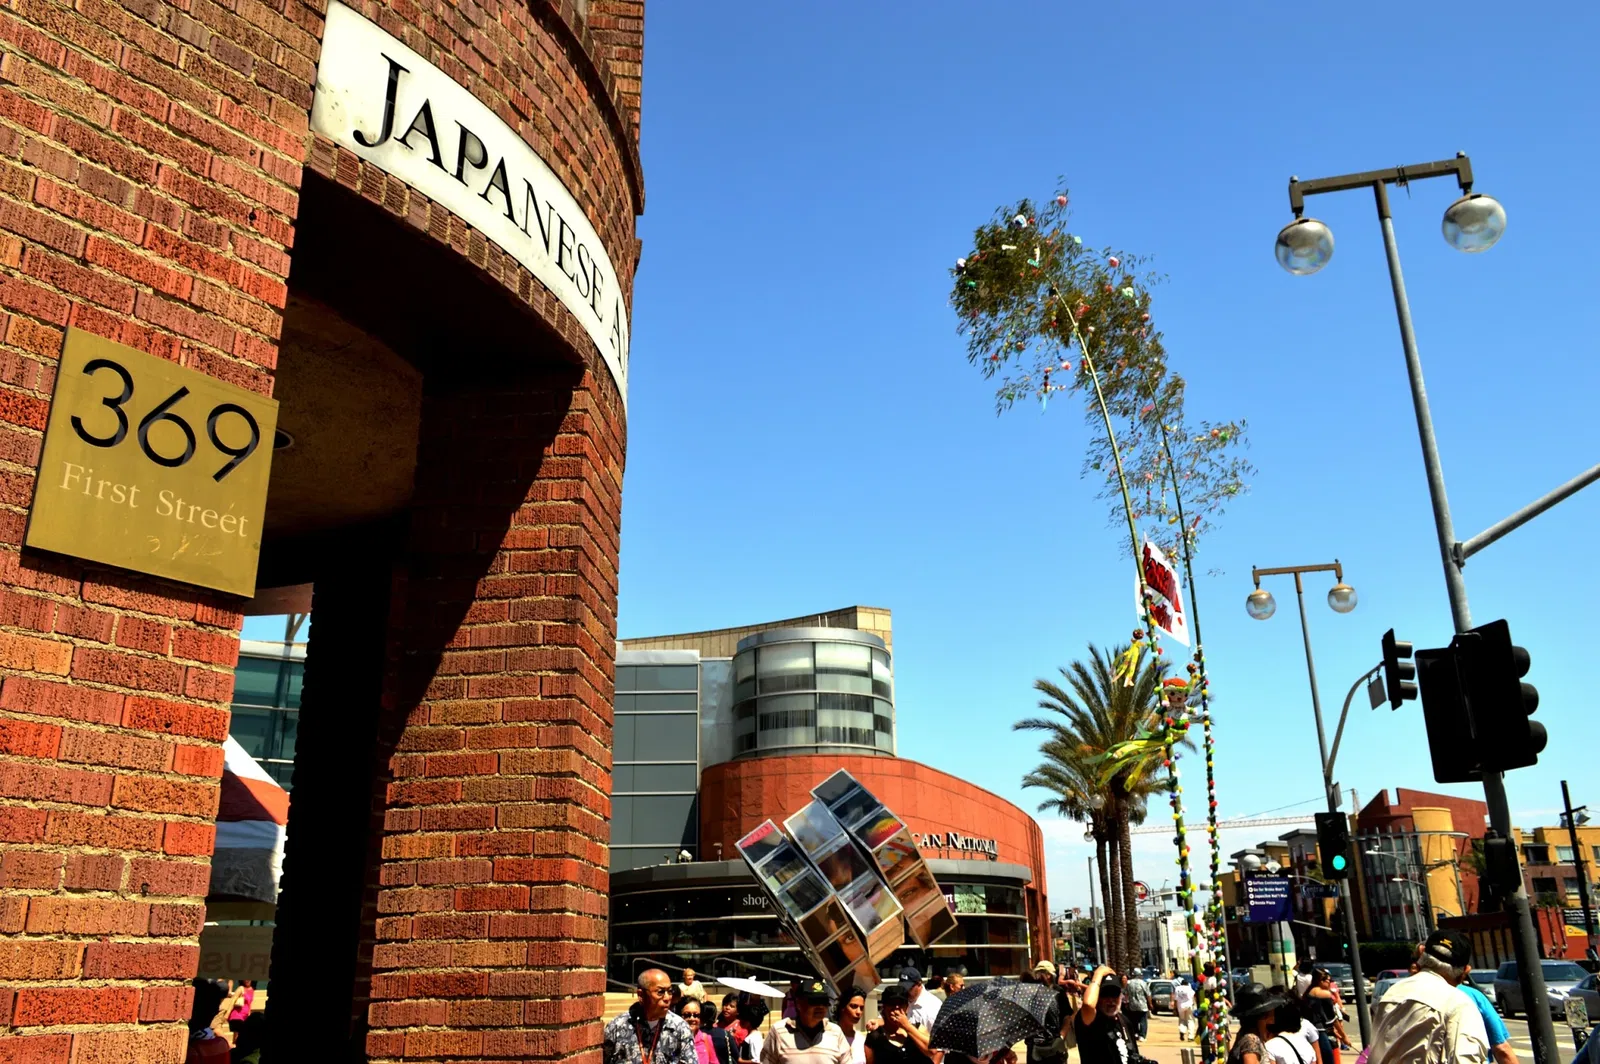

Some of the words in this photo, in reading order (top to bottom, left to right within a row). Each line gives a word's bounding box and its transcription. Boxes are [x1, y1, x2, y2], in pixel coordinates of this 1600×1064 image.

[353, 53, 604, 323] JAPANESE
[71, 359, 260, 483] 369
[59, 461, 141, 508] First
[156, 489, 249, 537] Street
[742, 893, 769, 909] shop
